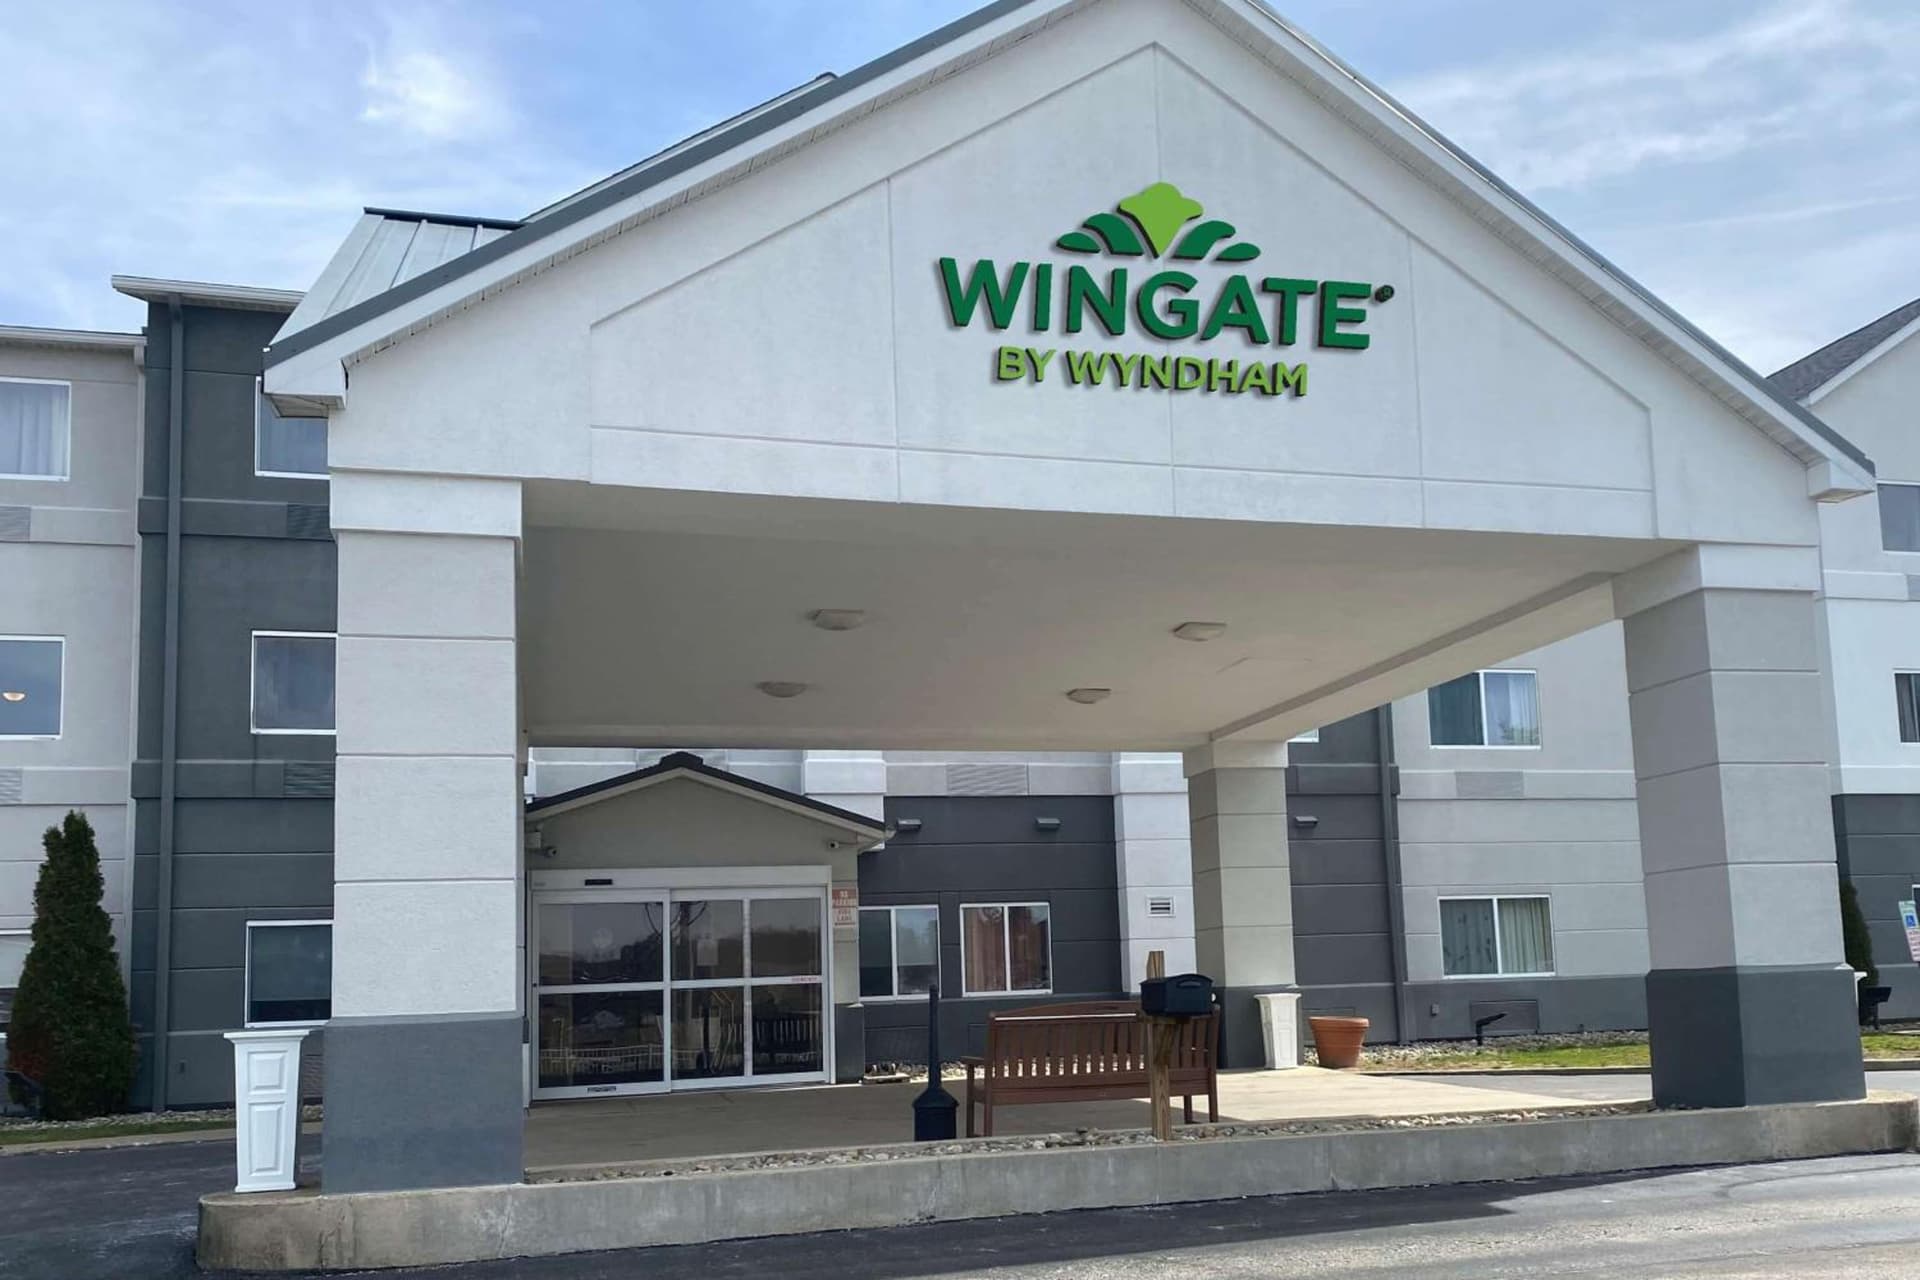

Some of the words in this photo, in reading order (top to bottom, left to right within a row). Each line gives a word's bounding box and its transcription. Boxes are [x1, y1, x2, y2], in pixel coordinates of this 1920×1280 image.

[939, 257, 1372, 350] WINGATE
[998, 346, 1056, 382] BY
[1066, 350, 1308, 396] WYNDHAM
